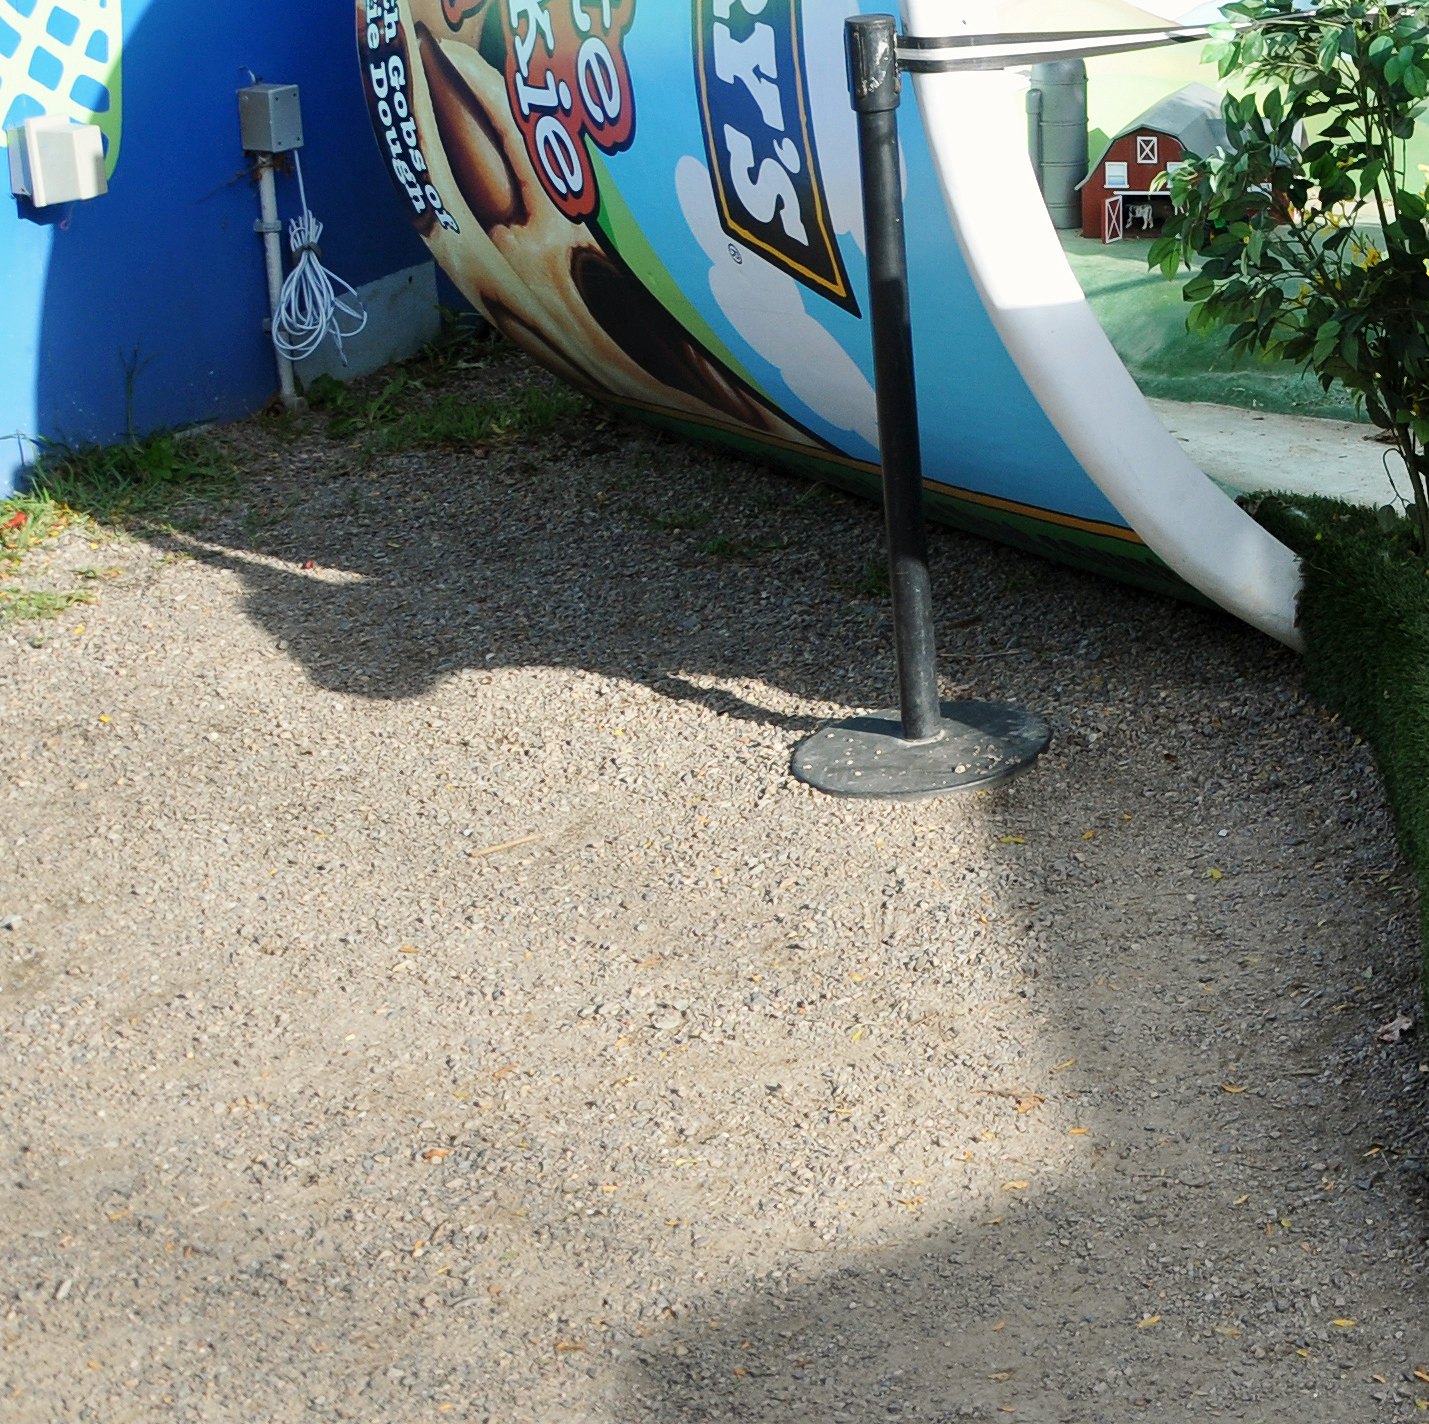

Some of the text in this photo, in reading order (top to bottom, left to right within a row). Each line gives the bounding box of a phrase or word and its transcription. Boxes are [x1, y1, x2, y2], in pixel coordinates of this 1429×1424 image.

[370, 62, 427, 214] Dough
[388, 55, 428, 174] Gobs
[424, 183, 461, 234] of
